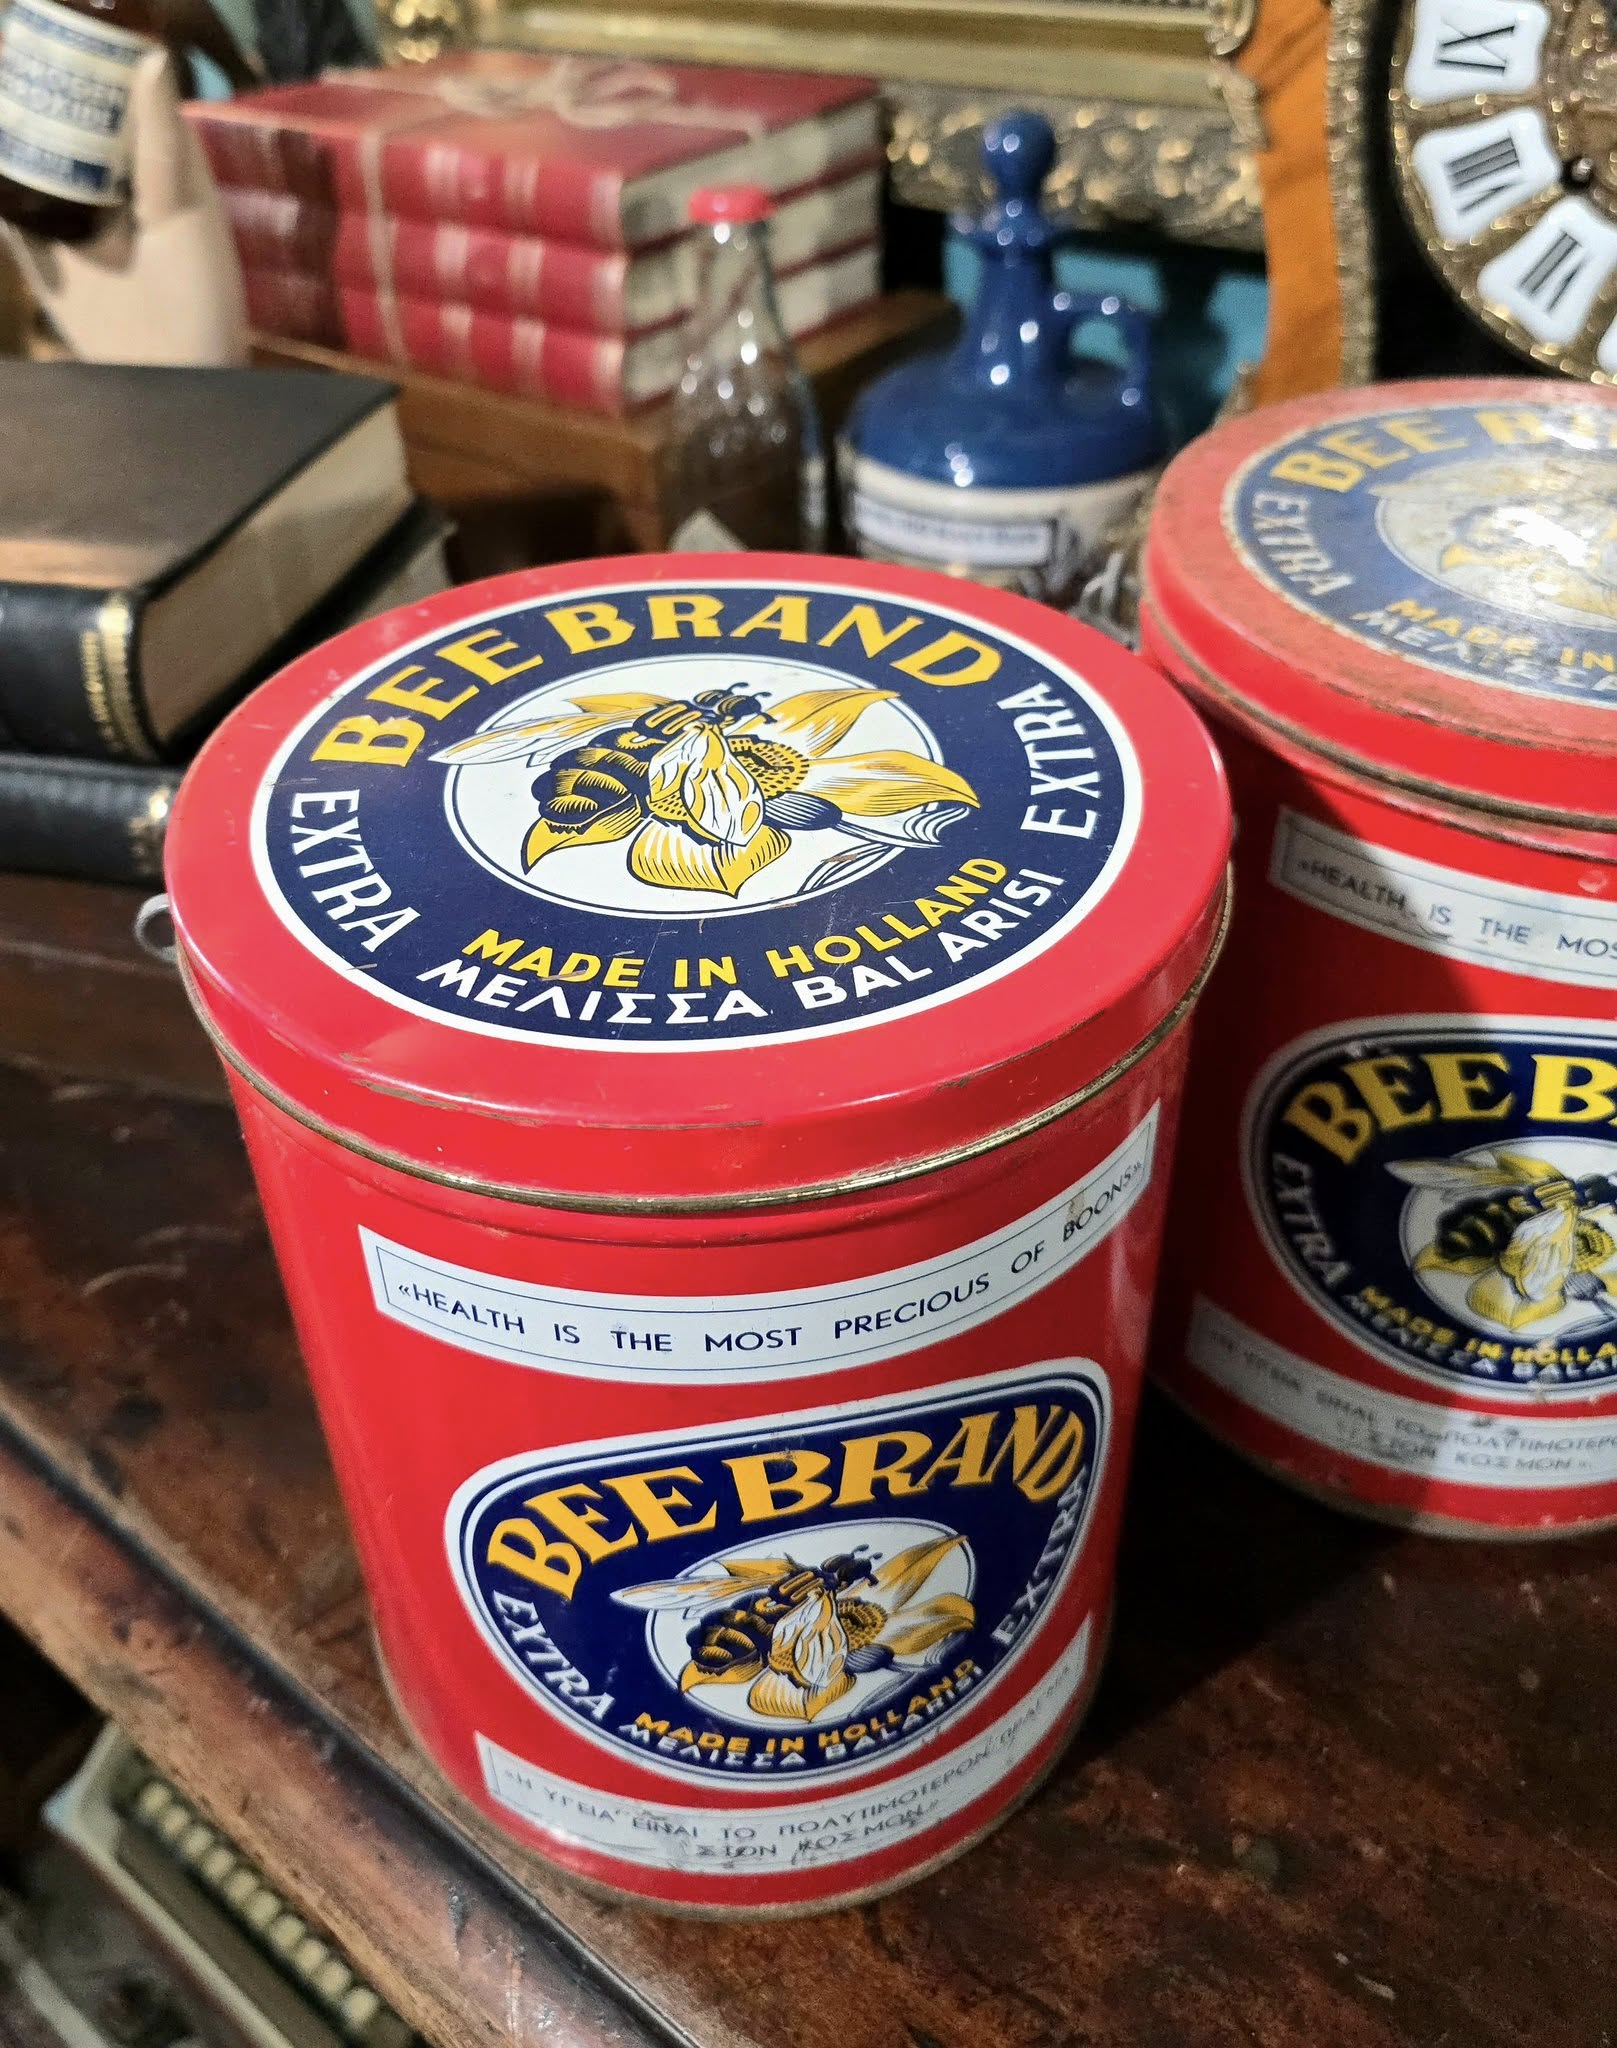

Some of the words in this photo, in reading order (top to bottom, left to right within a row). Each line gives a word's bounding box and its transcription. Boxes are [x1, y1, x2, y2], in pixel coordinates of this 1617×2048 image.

[1514, 229, 1594, 316] VII
[1270, 412, 1470, 493] BEE
[311, 628, 544, 767] BEE
[544, 594, 1002, 687] BRAND
[1559, 647, 1617, 673] IN
[996, 681, 1101, 840] EXTRA
[290, 788, 421, 952] EXTRA
[462, 928, 645, 988] MADE
[674, 955, 737, 988] IN
[765, 857, 1008, 979] HOLLAND
[1428, 903, 1452, 925] IS
[1479, 915, 1531, 945] THE
[416, 958, 769, 1024] ΜΕΛΙΣΣΑ
[791, 955, 933, 1010] BAL
[937, 868, 1065, 963] ARISI
[1282, 1052, 1516, 1164] BEE
[553, 1323, 581, 1345] IS
[610, 1330, 673, 1352] THE
[704, 1326, 802, 1352] MOST
[834, 1272, 990, 1340] PRECIOUS
[1010, 1239, 1046, 1275] OF
[486, 1465, 717, 1602] BEE
[722, 1404, 1085, 1523] BRAND
[492, 1589, 616, 1721] EXTRA
[634, 1711, 750, 1753] MADE
[765, 1735, 805, 1754] IN
[818, 1658, 975, 1749] HOLLAND
